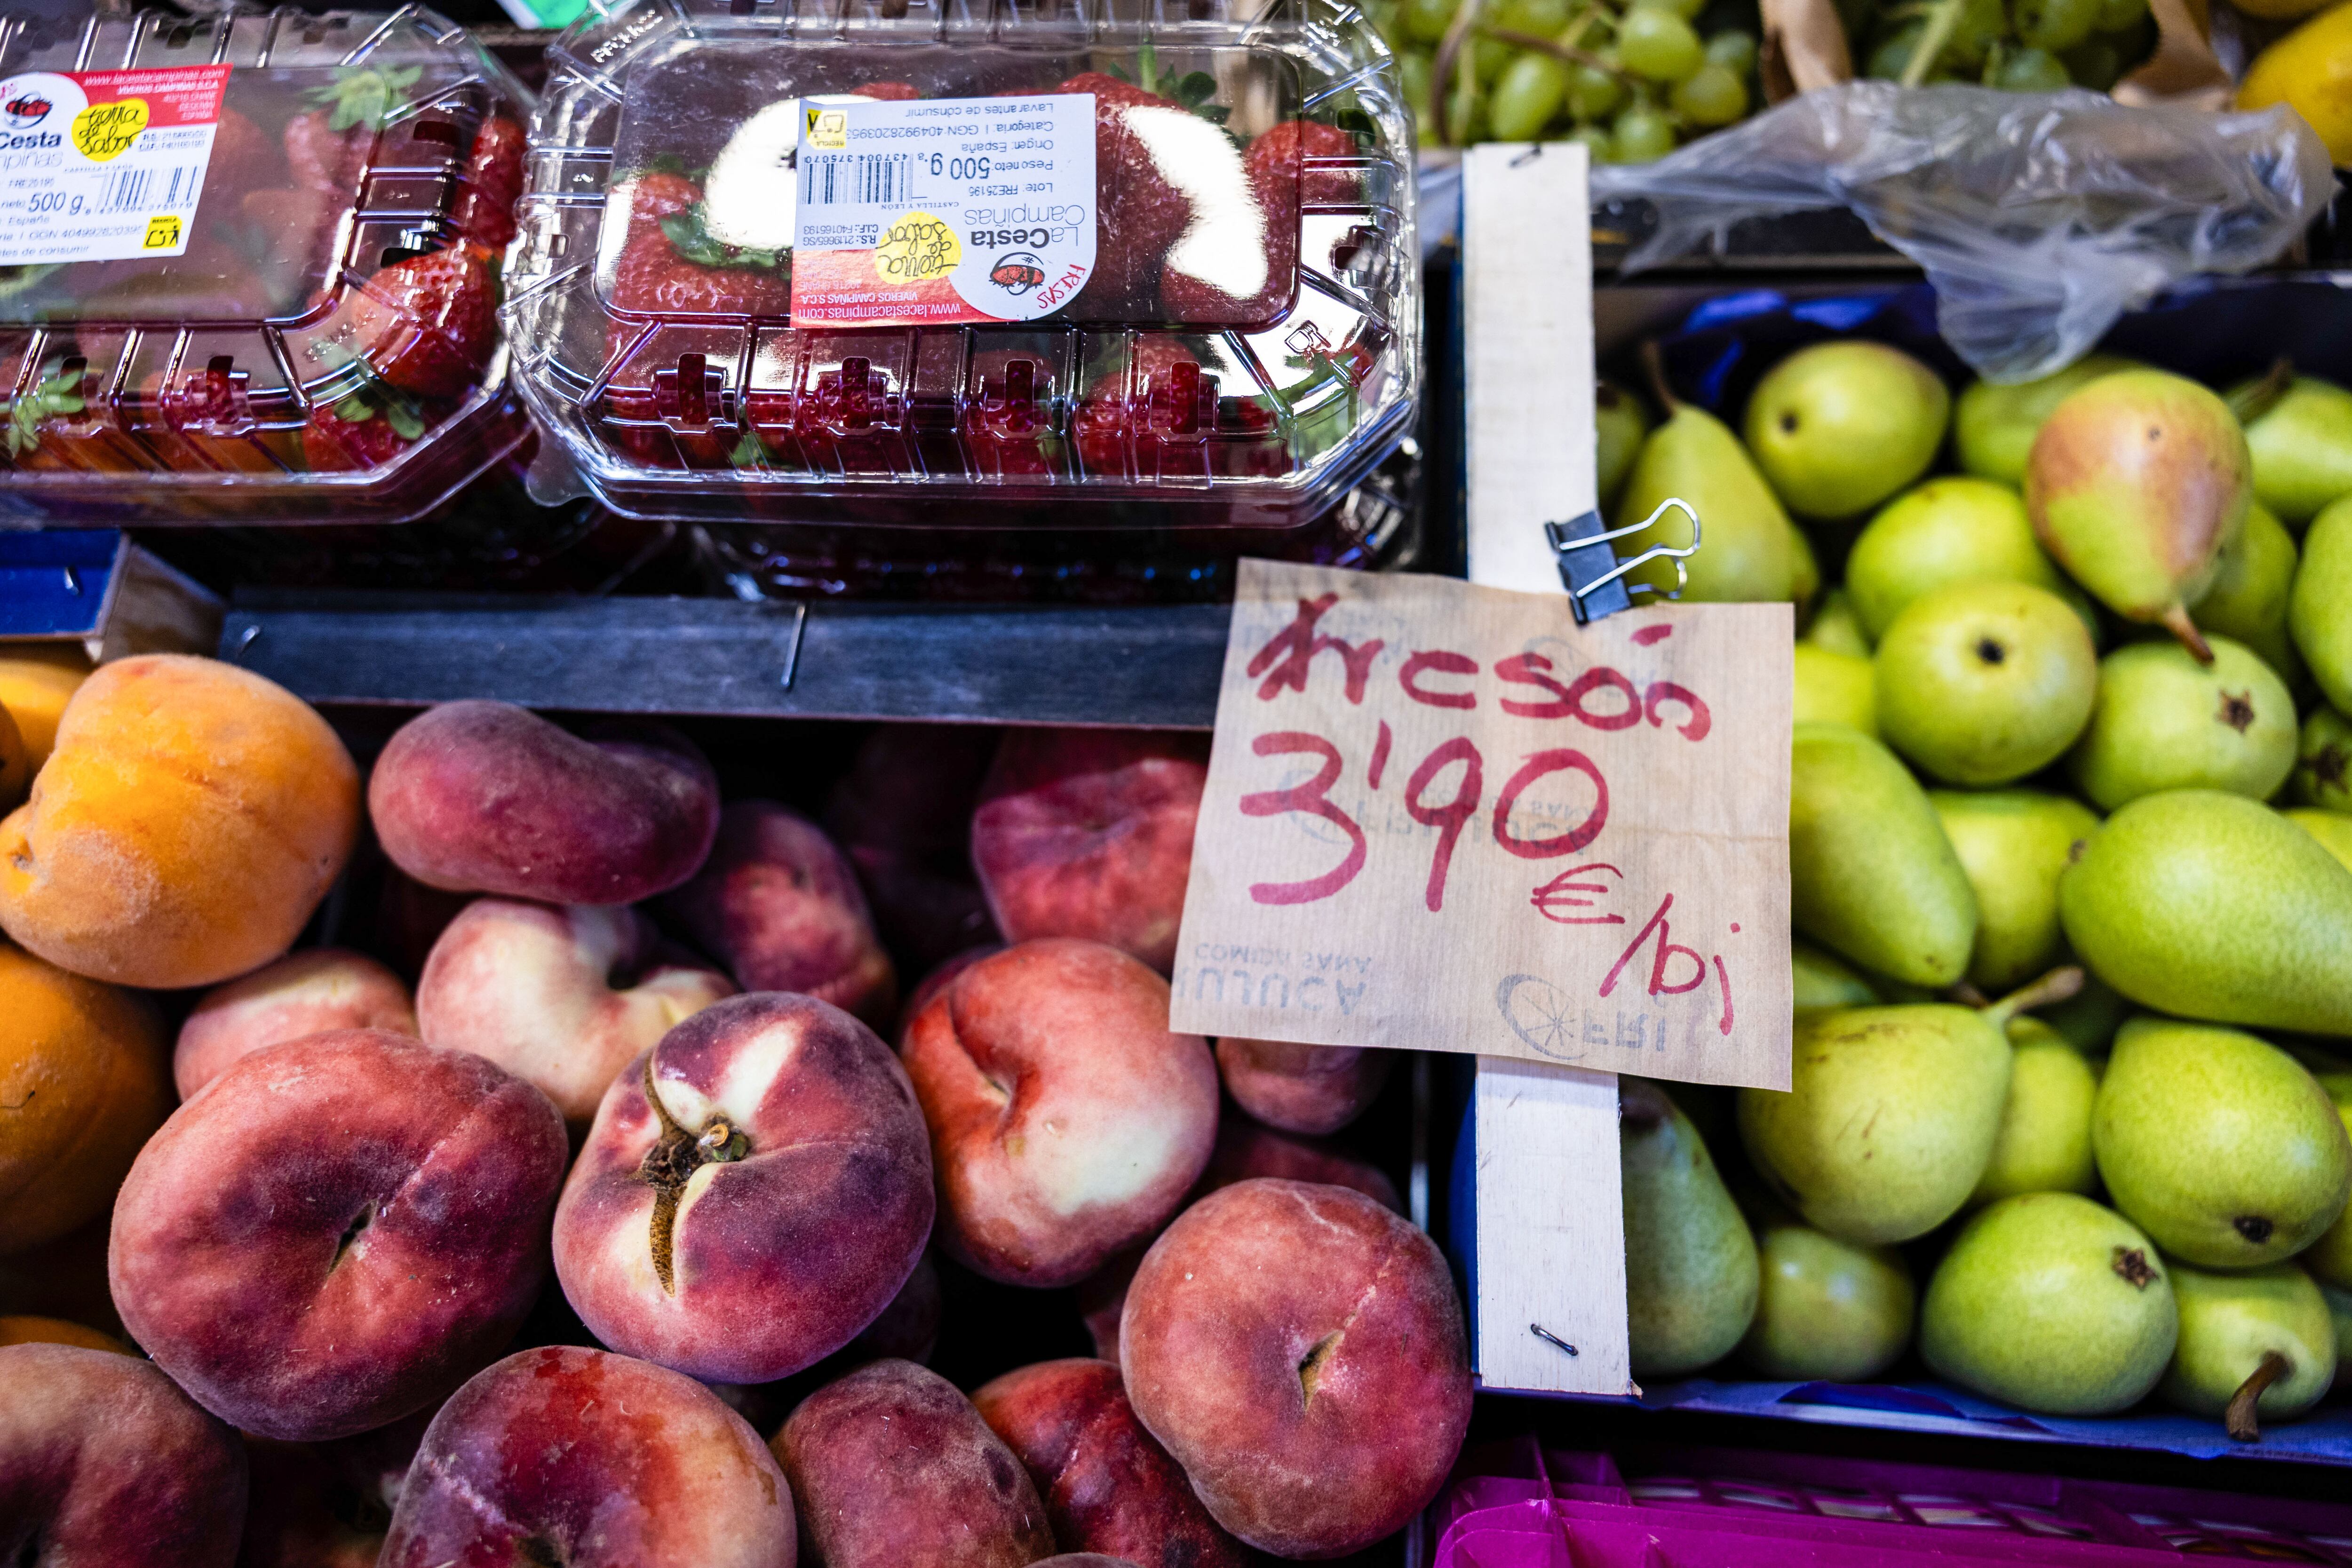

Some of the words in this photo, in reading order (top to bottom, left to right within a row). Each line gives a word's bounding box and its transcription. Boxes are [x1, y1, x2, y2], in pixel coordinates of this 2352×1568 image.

[906, 107, 962, 118] consumir
[966, 106, 981, 116] de
[985, 105, 1017, 114] antes
[1019, 103, 1054, 113] Lavar
[961, 142, 1007, 153] España
[1011, 138, 1054, 151] Origen:
[858, 153, 908, 162] 437004
[950, 157, 990, 180] 500
[1021, 160, 1053, 170] Peso
[968, 184, 1018, 196] FRE25195
[1023, 183, 1053, 192] Lote:
[28, 191, 67, 212] 500
[965, 203, 1085, 228] Campiñas
[803, 225, 853, 235] F40165193
[875, 222, 947, 256] sabor
[927, 241, 952, 255] de
[878, 254, 958, 277] tierra
[1037, 264, 1087, 309] FRESAS
[828, 293, 875, 305] CAMPIÑAS
[879, 292, 917, 302] VIVEROS
[799, 302, 961, 321] www.lacestacampinas.com
